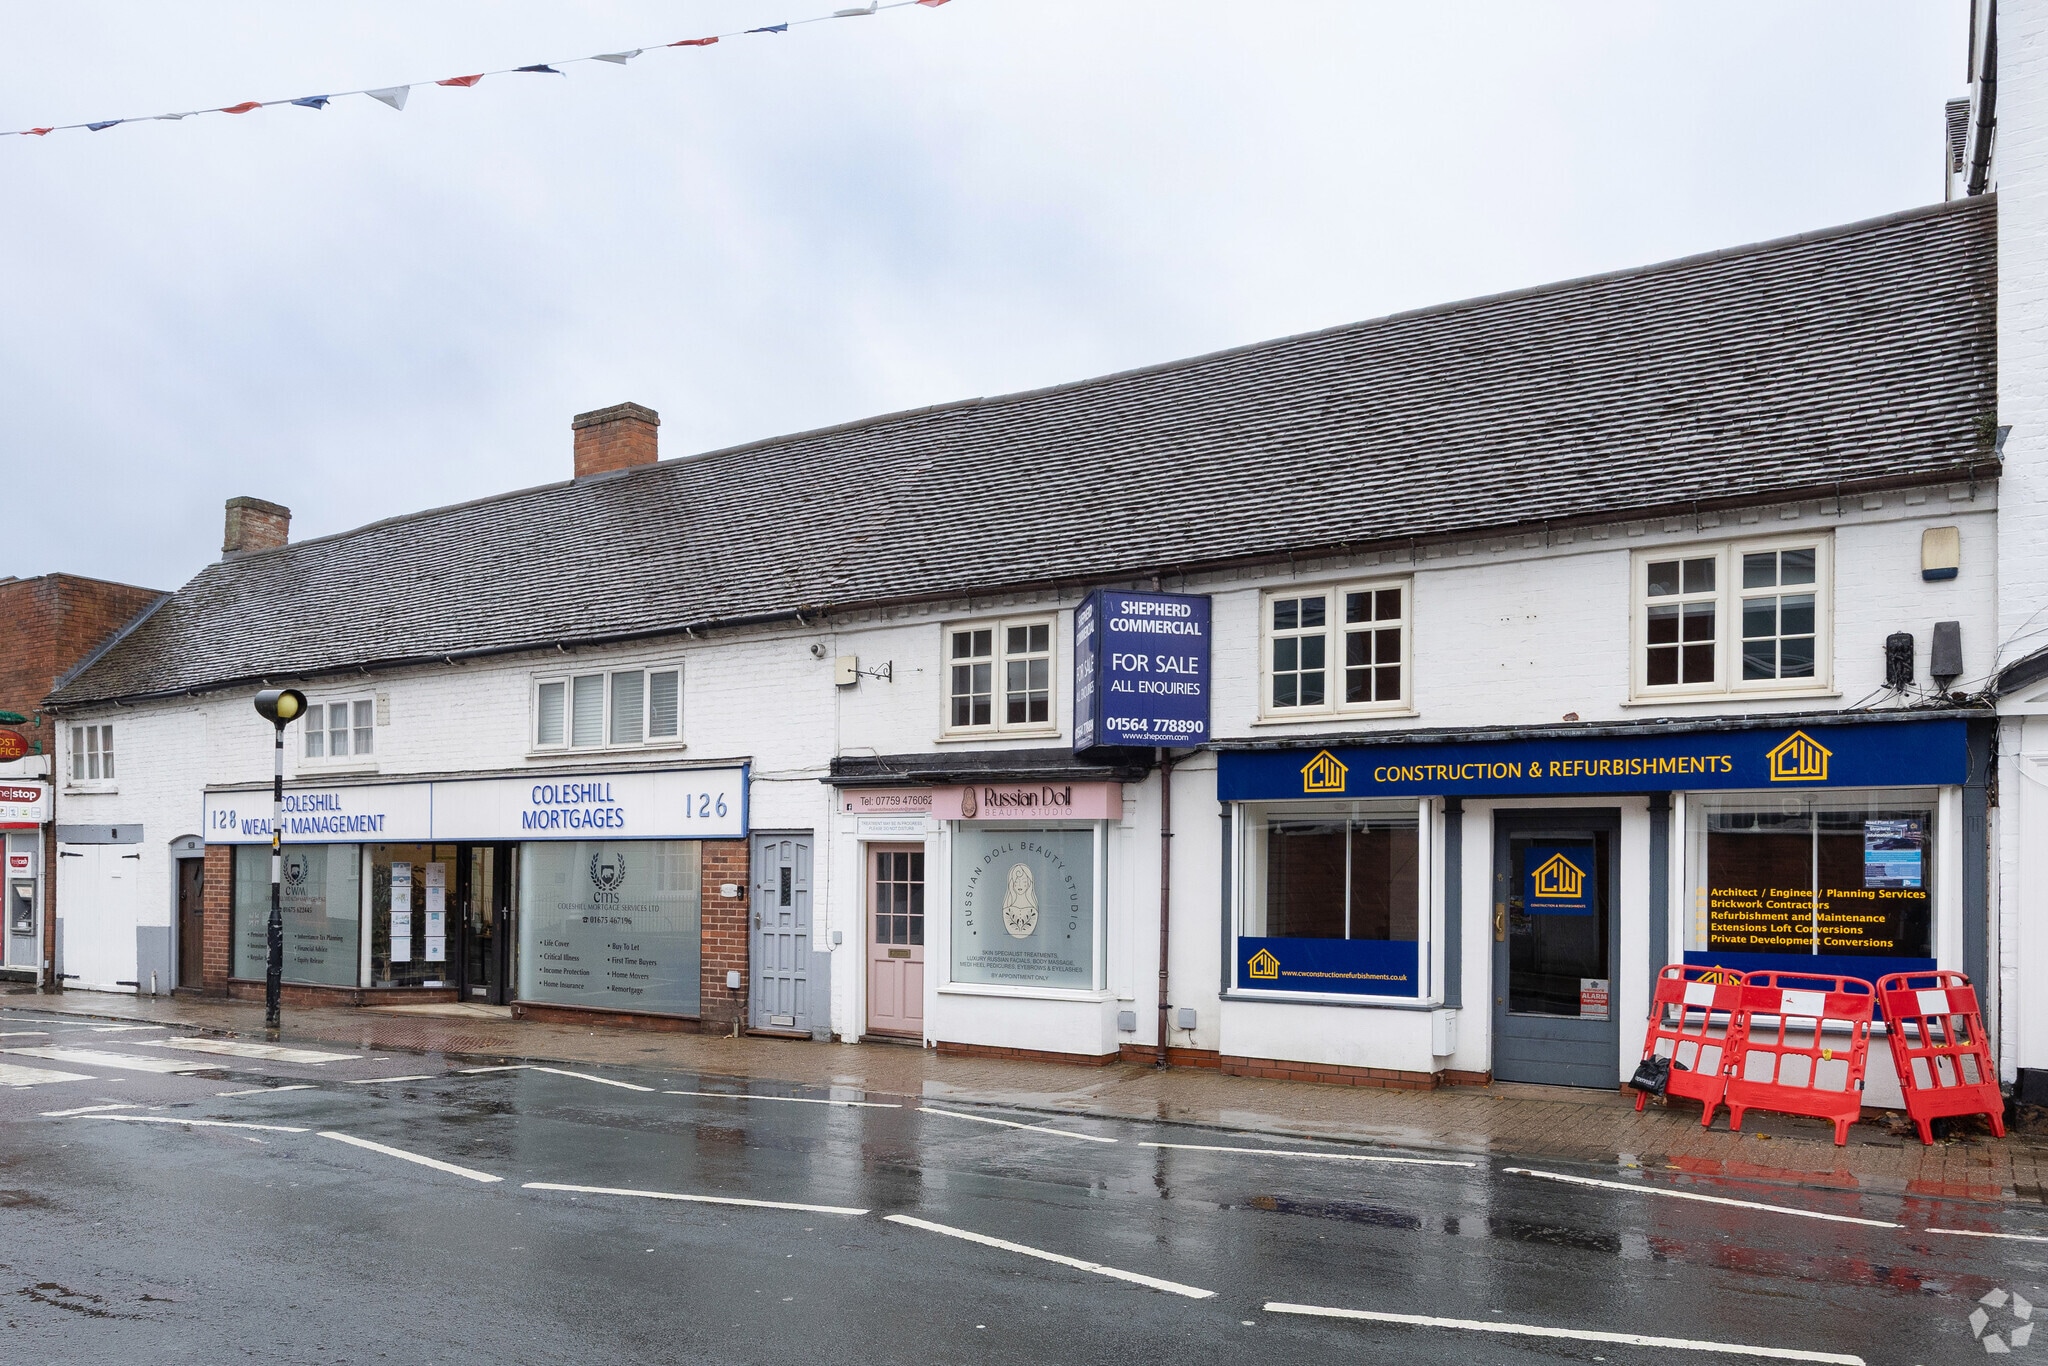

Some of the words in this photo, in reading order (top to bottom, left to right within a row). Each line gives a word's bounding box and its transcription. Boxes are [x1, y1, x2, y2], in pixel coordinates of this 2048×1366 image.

[1122, 601, 1191, 618] SHEPHERD
[1110, 618, 1202, 635] COMMERCIAL
[1112, 653, 1149, 672] FOR
[1156, 655, 1198, 674] SALE
[1111, 680, 1134, 692] ALL
[1138, 680, 1200, 695] ENQUIRIES
[1106, 717, 1148, 731] 01564
[1153, 719, 1204, 733] 778890
[1122, 732, 1189, 740] www.shepcom.com
[0, 738, 16, 746] OST
[0, 747, 20, 756] FICE
[1374, 762, 1522, 782] CONSTRUCTION
[1528, 761, 1542, 778] &
[1550, 755, 1732, 777] REFURBISHMENTS
[532, 783, 614, 805] COLESHILL
[984, 788, 1038, 806] Russian
[1041, 786, 1071, 806] Doll
[686, 792, 728, 818] 126
[860, 796, 874, 806] Tel:
[876, 796, 900, 806] 07759
[902, 795, 932, 805] 476062
[985, 808, 1026, 816] BEAUTY
[1032, 808, 1072, 816] STUDIO
[212, 810, 236, 828] 128
[241, 818, 286, 834] WEALH
[292, 814, 385, 833] MANAGEMENT
[522, 808, 624, 830] MORTGAGES
[965, 867, 982, 926] RUSSIAN
[984, 843, 1014, 864] DOLL
[1020, 842, 1065, 870] BEAUTY
[1064, 875, 1078, 930] STUDIO
[1711, 888, 1758, 896] Architect
[1762, 888, 1766, 898] /
[1826, 889, 1875, 899] Planning
[1879, 890, 1926, 899] Services
[558, 902, 586, 911] COLESHILL
[588, 904, 620, 912] MORTGAGE
[621, 904, 647, 912] SERVICES
[1711, 900, 1763, 908] Brickwork
[1766, 900, 1830, 910] Contractors
[590, 916, 608, 924] 01675
[610, 916, 632, 924] 467196
[1711, 911, 1788, 920] Refurbishment
[1792, 913, 1812, 921] and
[1814, 913, 1885, 922] Maintenance
[1711, 923, 1767, 932] Extensions
[1770, 924, 1792, 932] Loft
[1794, 924, 1863, 934] Conversions
[1711, 934, 1747, 943] Private
[1750, 936, 1820, 946] Development
[1824, 938, 1894, 948] Conversions
[612, 943, 622, 951] Buy
[563, 954, 579, 962] Illness
[638, 958, 657, 966] Buyers
[563, 968, 590, 976] Protection
[629, 972, 649, 980] Movers
[1282, 970, 1407, 981] www.cwconstructionrefurbishments.co.uk
[560, 981, 584, 989] Insurance
[611, 985, 643, 994] Remortgage
